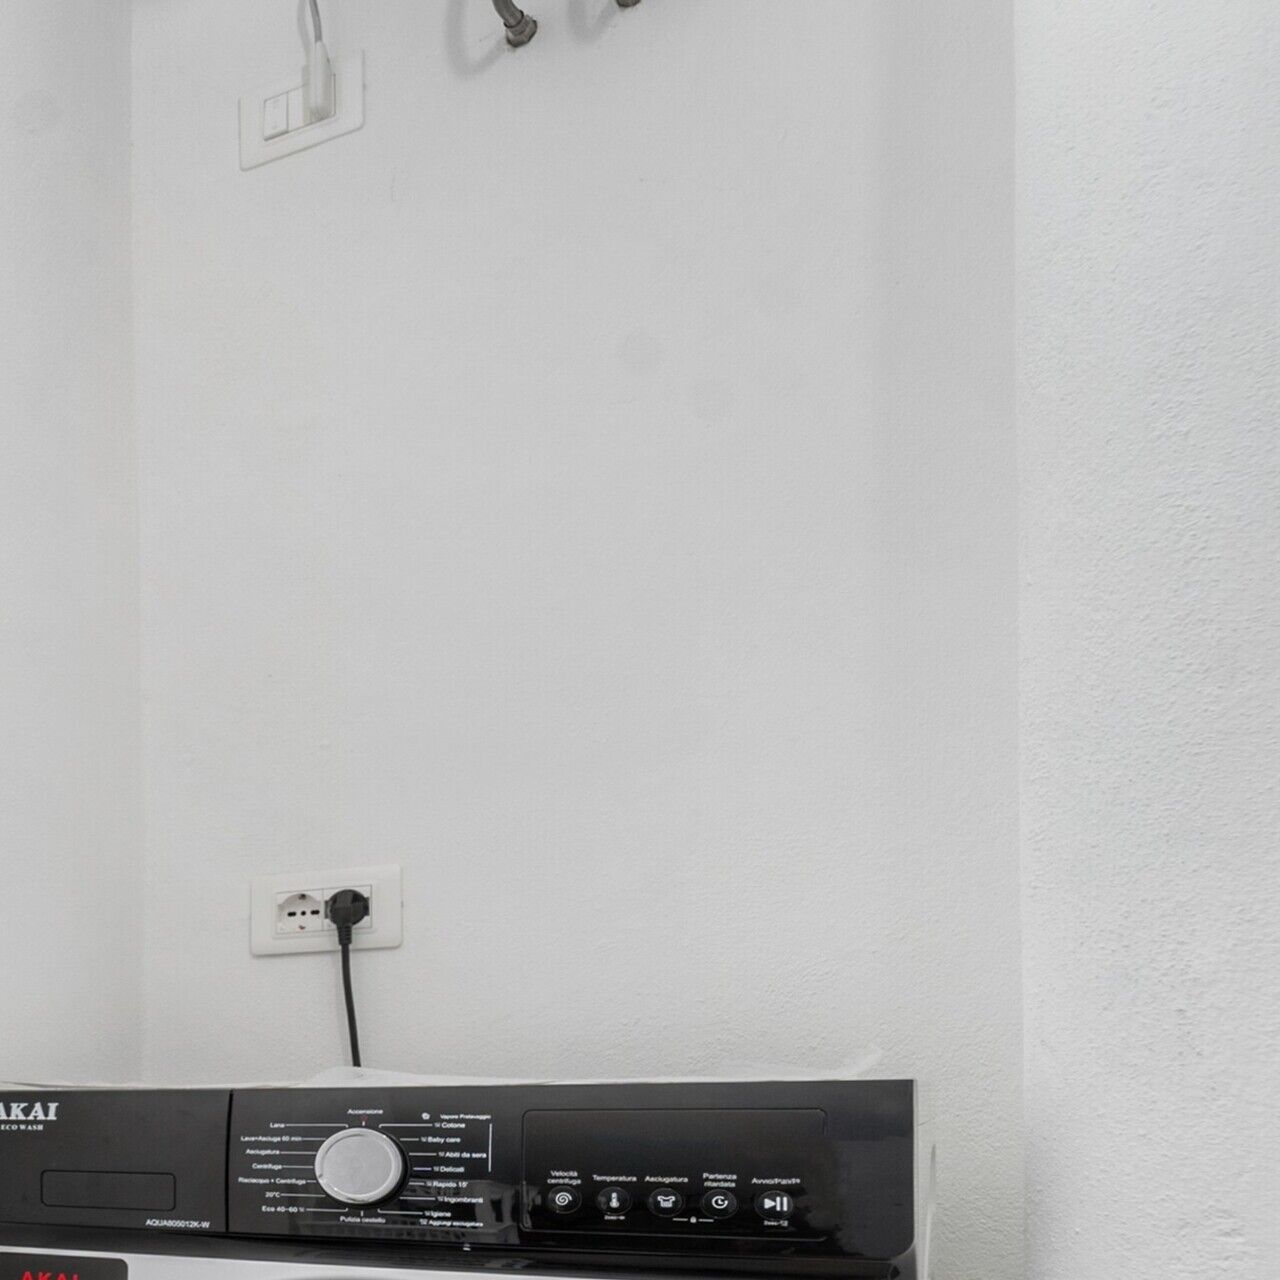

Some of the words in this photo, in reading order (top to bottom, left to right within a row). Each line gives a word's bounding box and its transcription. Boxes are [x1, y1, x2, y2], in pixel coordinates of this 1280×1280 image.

[427, 1136, 444, 1144] Baby
[592, 1174, 637, 1182] Temperatura
[703, 1172, 737, 1180] Partenza
[433, 1180, 457, 1188] Rapido
[444, 1196, 484, 1204] Ingombranti
[431, 1210, 452, 1218] Igiene
